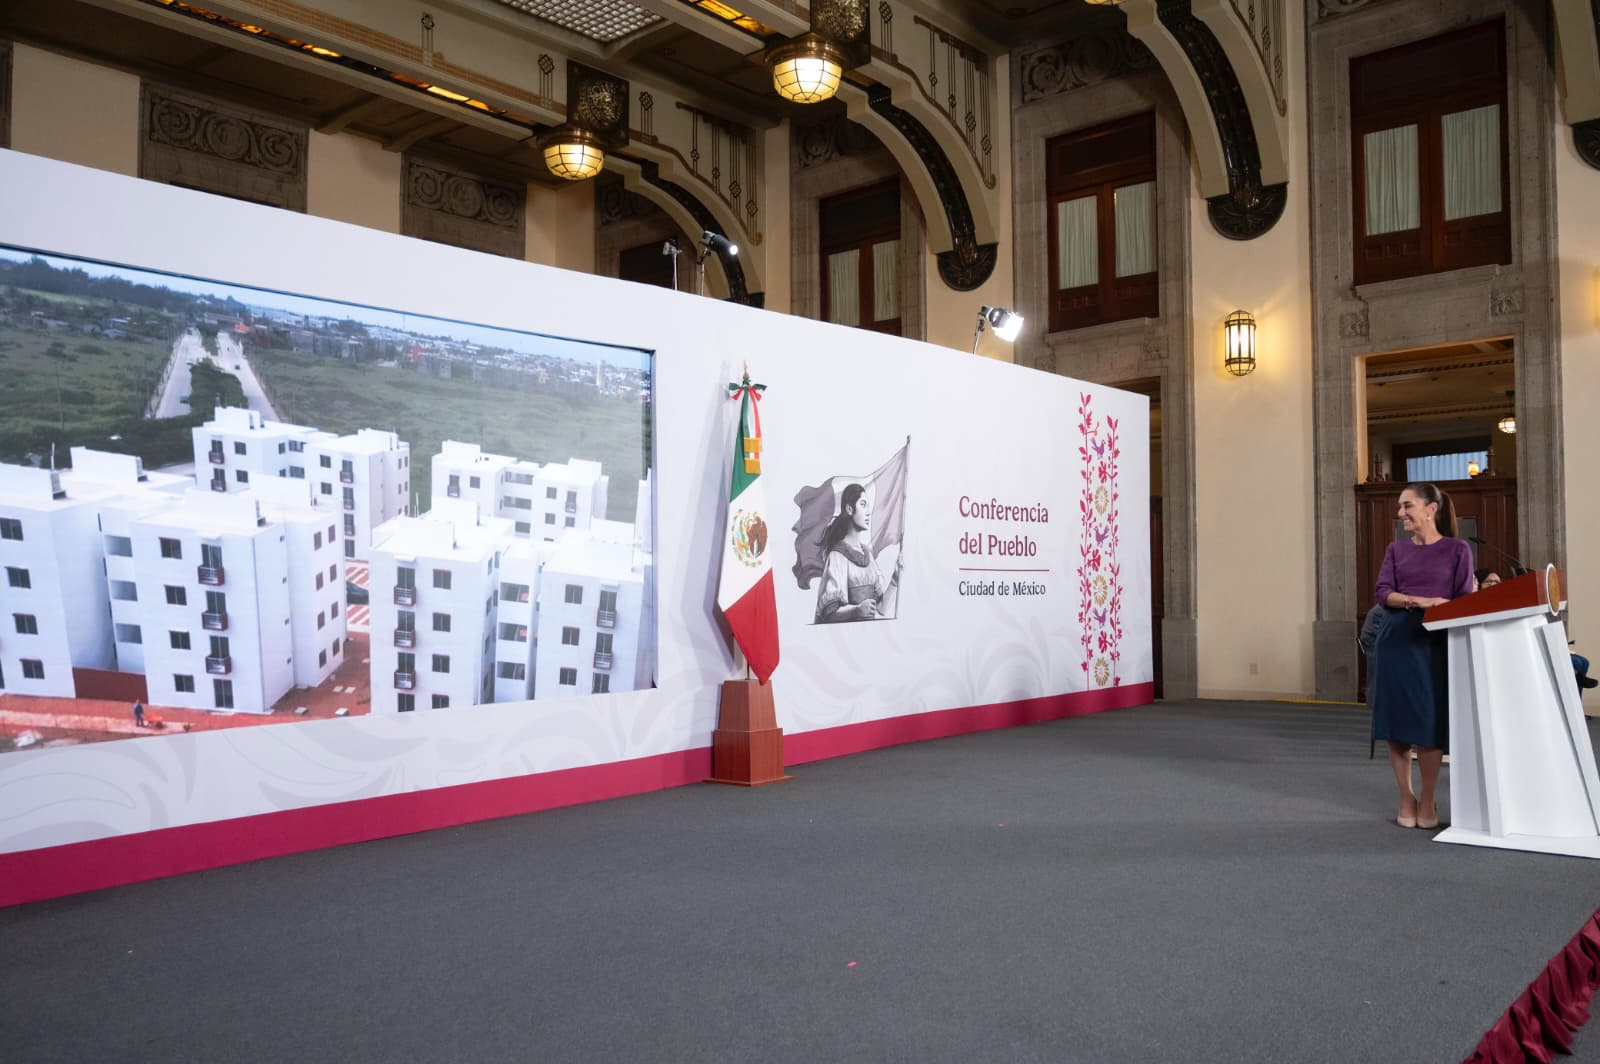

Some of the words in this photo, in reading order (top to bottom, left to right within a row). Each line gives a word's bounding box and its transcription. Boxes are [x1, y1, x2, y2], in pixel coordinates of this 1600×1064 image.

[959, 495, 1048, 523] Conferencia
[959, 531, 982, 555] del
[988, 534, 1037, 557] Pueblo
[959, 580, 995, 596] Ciudad
[998, 581, 1009, 596] de
[1013, 580, 1046, 596] México
